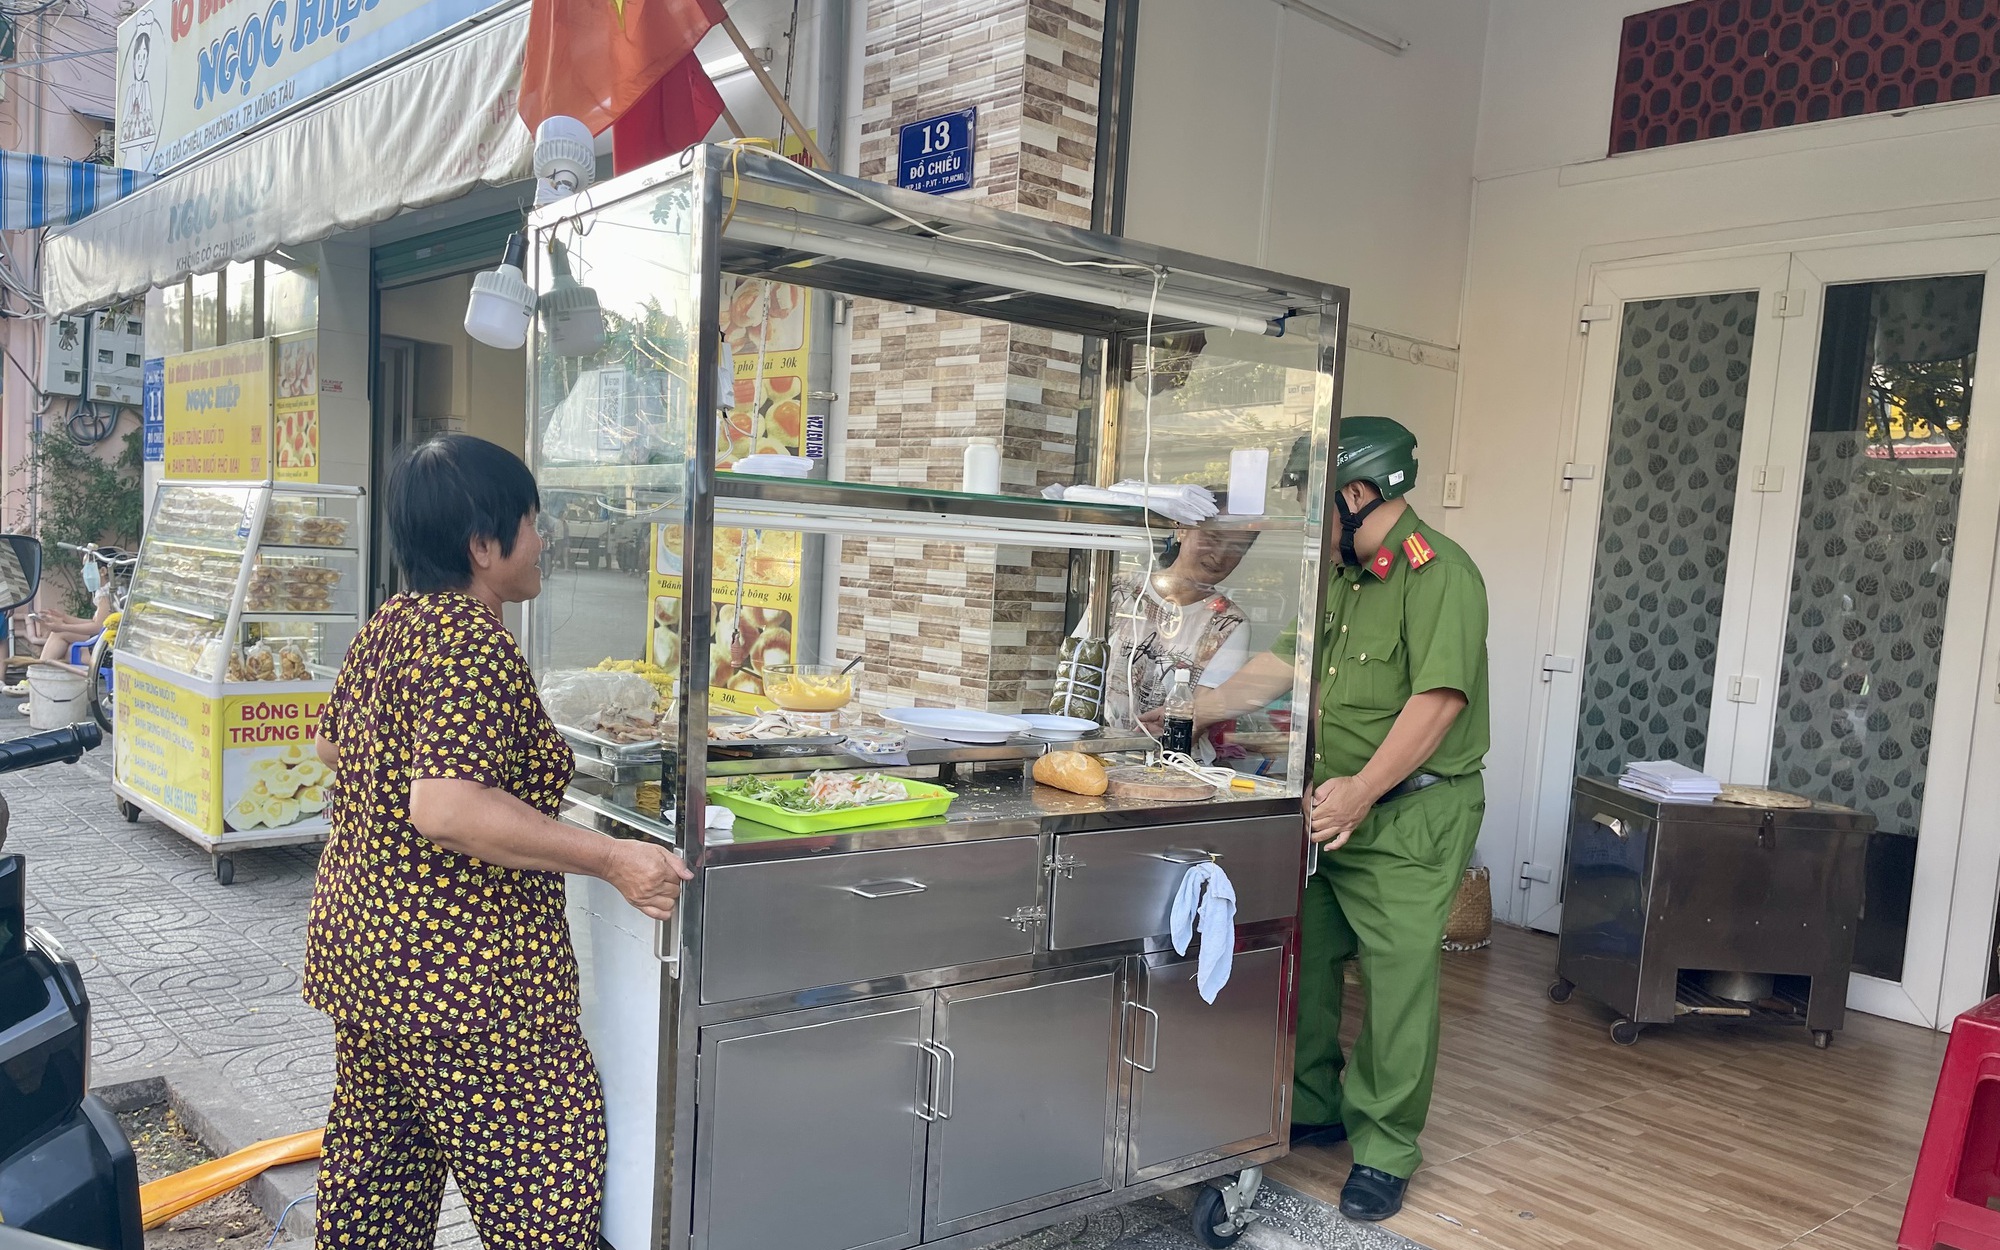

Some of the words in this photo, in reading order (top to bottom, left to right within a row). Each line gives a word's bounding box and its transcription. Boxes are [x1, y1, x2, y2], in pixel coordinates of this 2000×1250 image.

[194, 0, 287, 109] NGỌC
[254, 91, 277, 118] VŨNG
[278, 80, 296, 106] TÀU
[922, 120, 950, 154] 13
[910, 160, 925, 180] ĐỒ
[928, 151, 960, 176] CHIỂU
[168, 187, 219, 247] NGỌC
[176, 250, 200, 272] KHÔNG
[200, 244, 211, 262] CÓ
[213, 243, 228, 258] CHI
[230, 231, 256, 254] NHÁNH
[737, 360, 754, 374] phô
[780, 357, 798, 368] 30k
[150, 390, 162, 421] 11
[186, 387, 214, 414] NGỌC
[806, 442, 823, 458] 0937
[748, 590, 768, 600] bông
[776, 592, 792, 602] 30k
[242, 702, 298, 721] BÔNG
[304, 703, 324, 718] LA
[721, 694, 736, 704] 30k
[229, 723, 300, 743] TRỨNG
